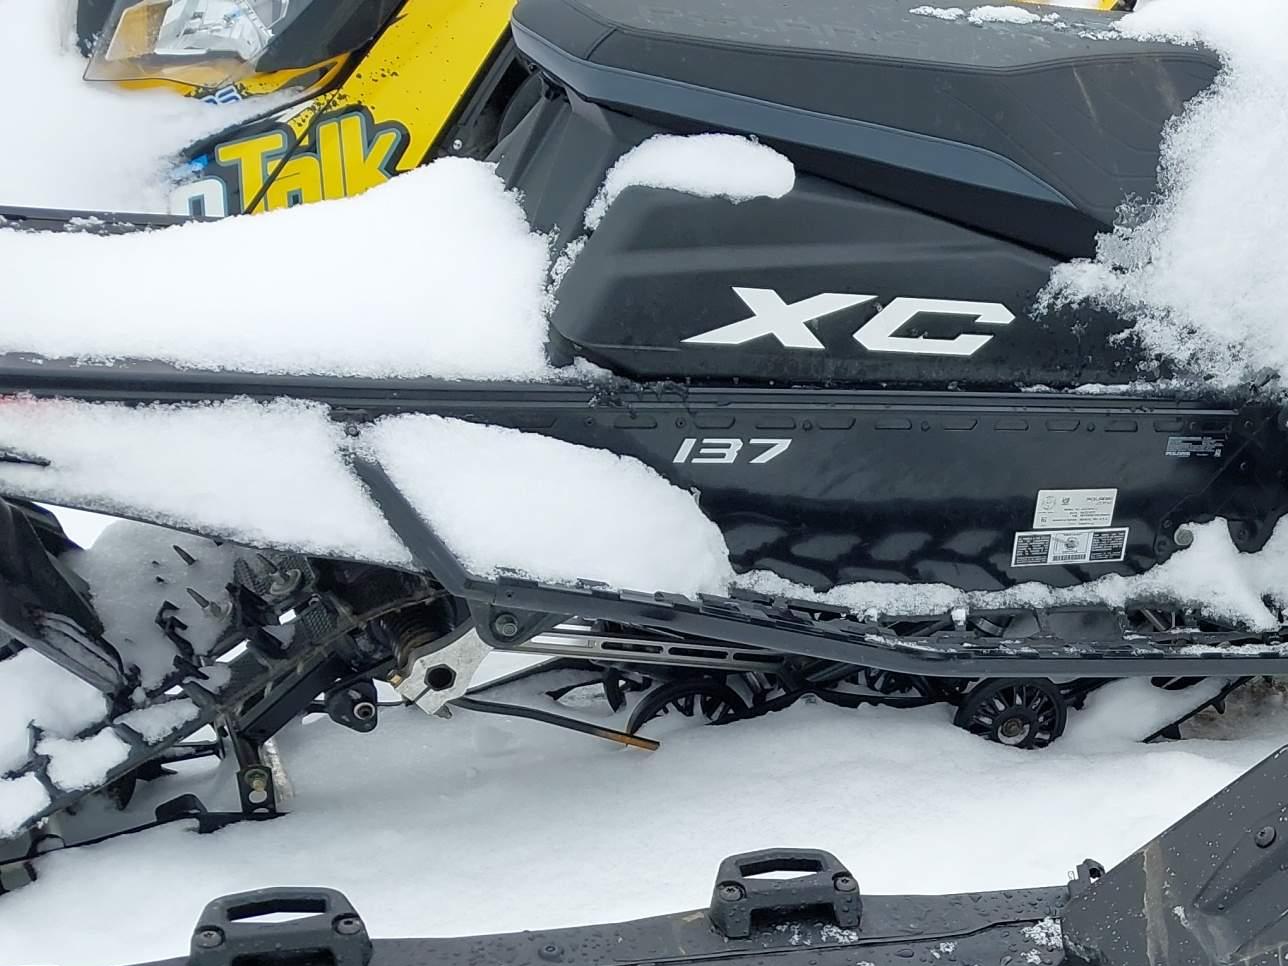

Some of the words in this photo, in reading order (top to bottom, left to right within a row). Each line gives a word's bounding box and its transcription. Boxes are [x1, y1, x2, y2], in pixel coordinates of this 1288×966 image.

[217, 114, 399, 215] Talk
[680, 286, 1016, 356] XC
[672, 438, 793, 464] 137
